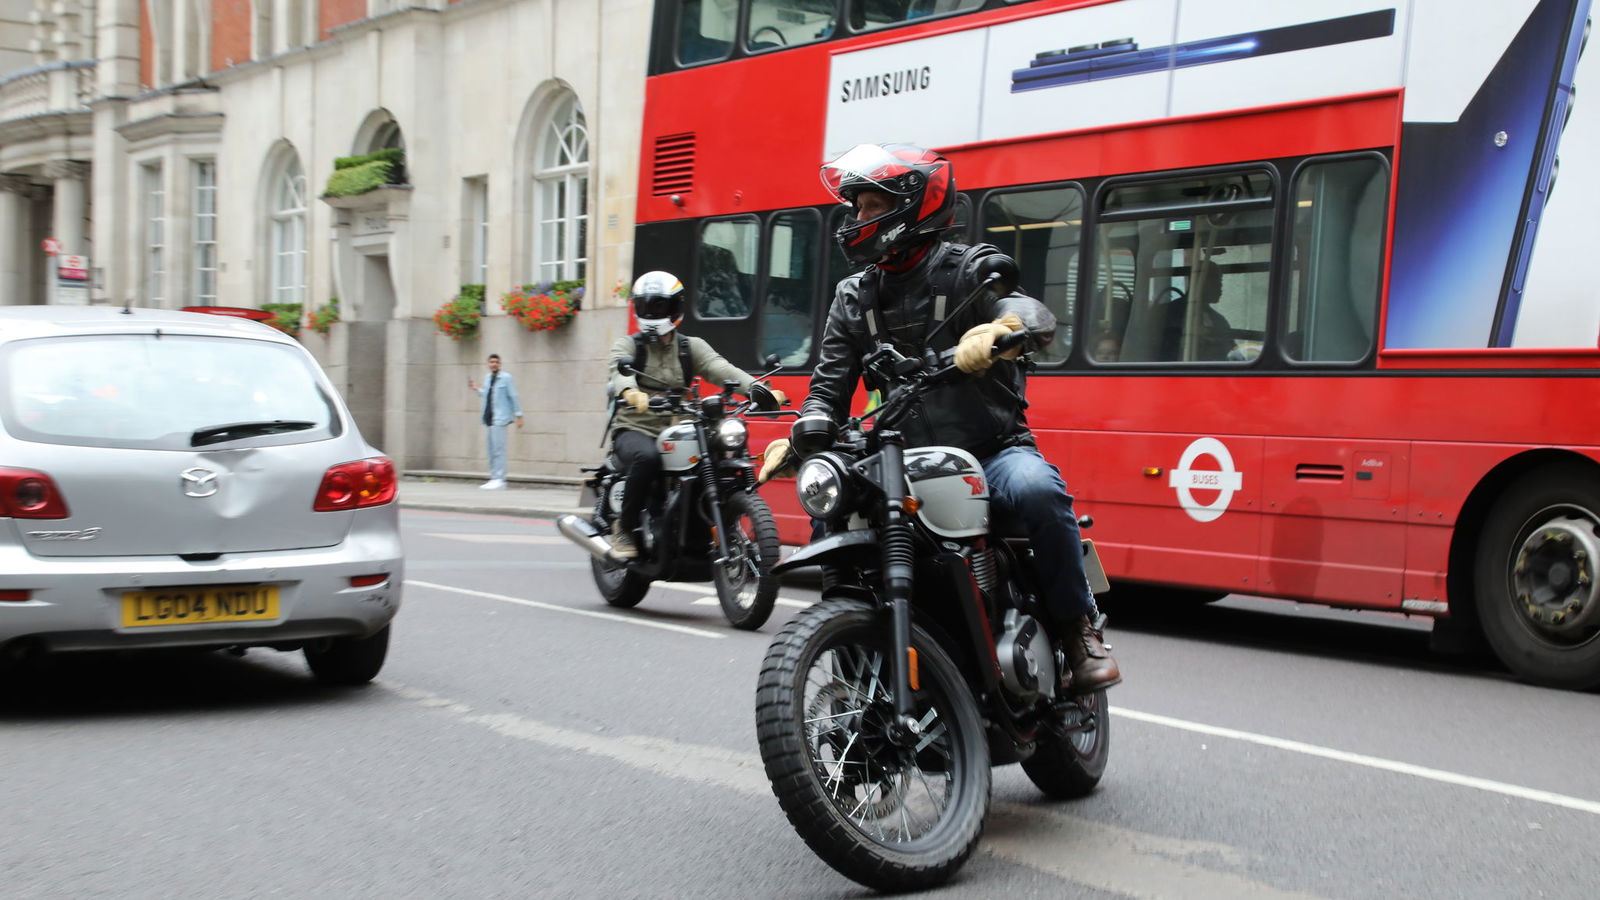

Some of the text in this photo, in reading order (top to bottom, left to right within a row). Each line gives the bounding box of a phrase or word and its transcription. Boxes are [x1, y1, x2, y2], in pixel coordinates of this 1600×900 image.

[841, 66, 930, 103] SAMSUNG
[881, 222, 906, 243] HJC
[1192, 473, 1219, 485] BUSES
[134, 589, 269, 621] LG04 NDU
